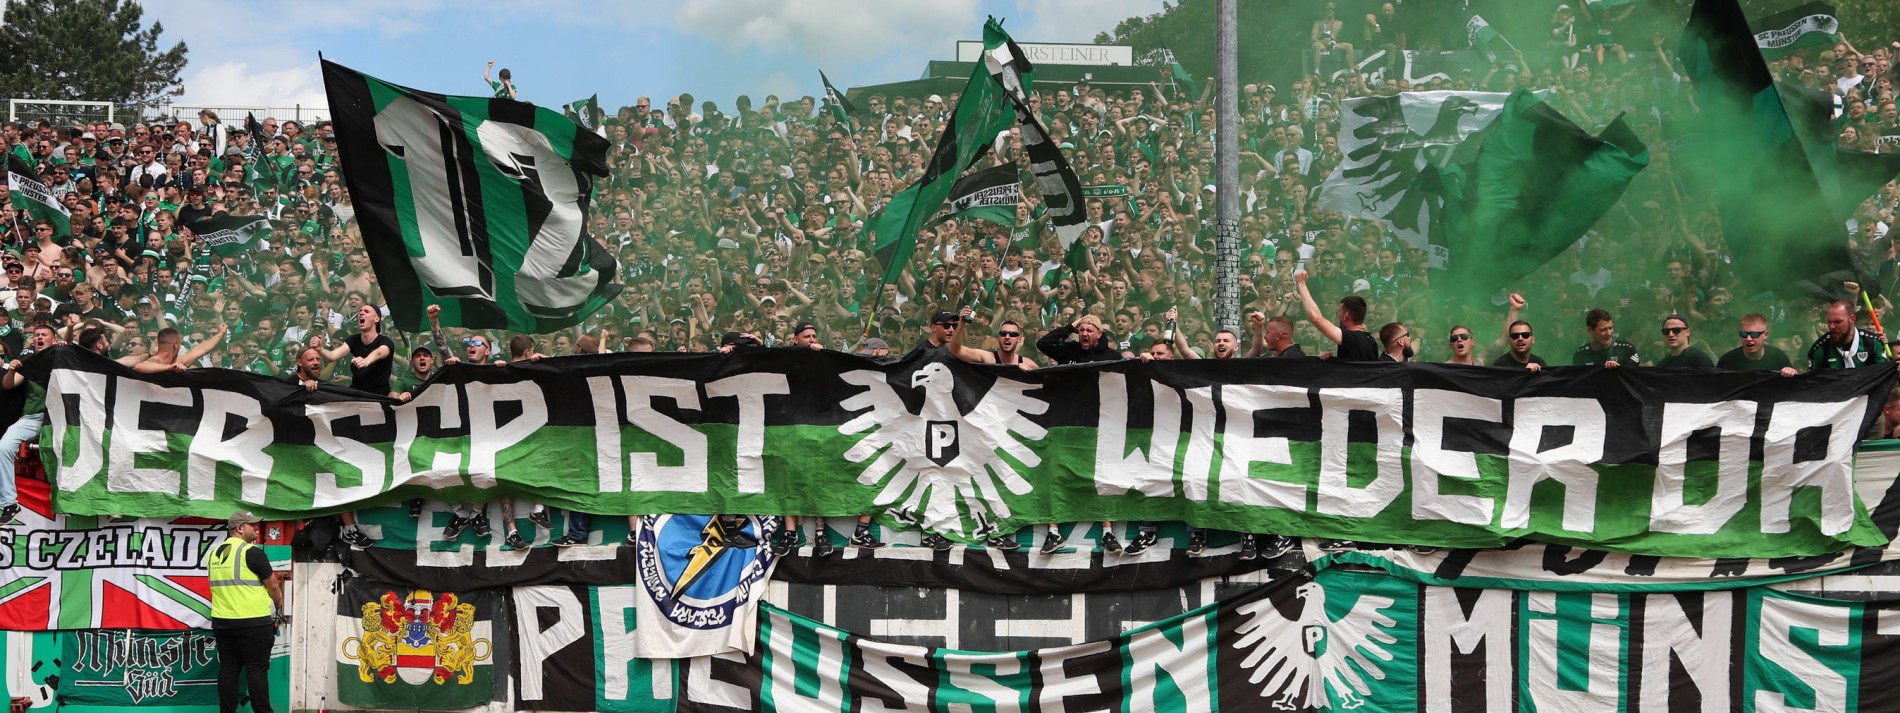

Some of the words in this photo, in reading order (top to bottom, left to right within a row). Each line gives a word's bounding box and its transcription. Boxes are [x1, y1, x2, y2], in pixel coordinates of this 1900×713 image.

[1758, 32, 1769, 41] SC
[1771, 18, 1807, 38] PREUSSEN
[1023, 46, 1110, 62] ARSTEINER
[18, 175, 52, 196] PREUSSE
[373, 95, 600, 318] 12
[1435, 247, 1447, 257] SC
[46, 368, 274, 506] DER
[305, 379, 548, 509] SCP
[586, 372, 789, 493] IST
[1094, 371, 1607, 533] WIEDER
[1649, 395, 1868, 537] DA
[931, 424, 955, 459] P
[670, 602, 727, 628] PESCARA
[1306, 625, 1323, 653] P
[72, 629, 222, 678] Münste
[126, 667, 178, 705] Süd
